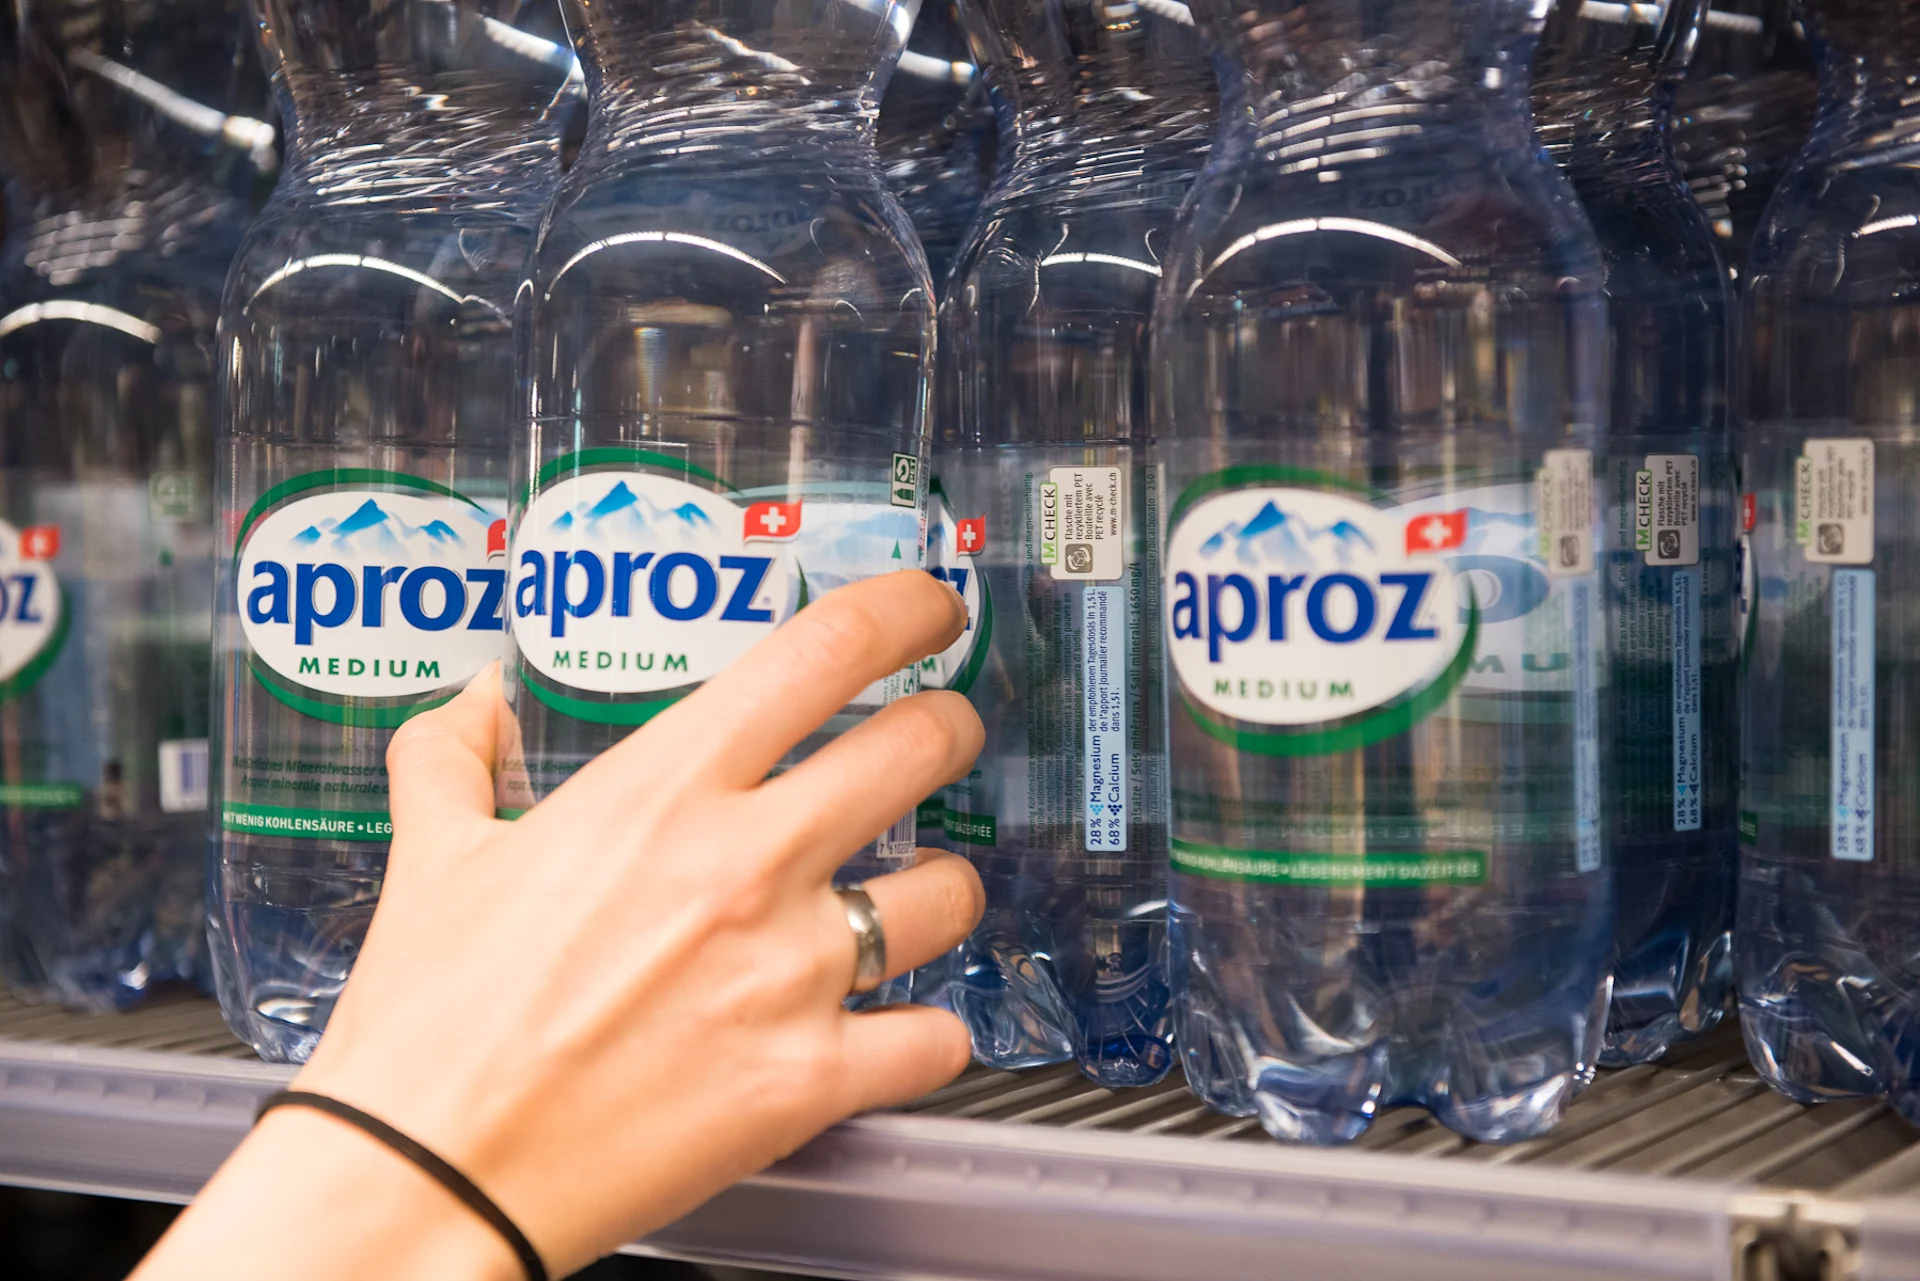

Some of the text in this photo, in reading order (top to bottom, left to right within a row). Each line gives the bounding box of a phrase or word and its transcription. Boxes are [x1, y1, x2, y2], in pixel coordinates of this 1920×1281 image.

[1147, 474, 1156, 490] 250
[1064, 494, 1073, 540] Flasche mit
[1074, 473, 1084, 540] rezykliertem PET
[1084, 503, 1093, 540] Bouteille
[1095, 495, 1105, 540] PET recyclé
[516, 550, 776, 638] aproz
[1087, 611, 1096, 619] in
[1097, 591, 1107, 643] recommandé
[1173, 571, 1440, 663] aproz
[552, 649, 689, 672] MEDIUM
[1086, 621, 1098, 664] Tagesdosis
[1129, 619, 1140, 667] minerali:
[298, 656, 441, 678] MEDIUM
[1097, 645, 1108, 685] journalier
[1129, 671, 1140, 689] Sali
[1087, 665, 1098, 718] empfohlenen
[1215, 678, 1354, 700] MEDIUM
[1087, 719, 1096, 732] der
[1098, 721, 1107, 732] de
[1110, 712, 1120, 732] dans
[1131, 701, 1141, 749] minéraux
[286, 760, 378, 776] Mineralwasser
[1090, 735, 1103, 802] Magnesium
[1131, 753, 1142, 775] Sels
[1676, 717, 1688, 783] Magnesium
[1689, 734, 1698, 782] Calcium
[271, 777, 321, 792] minerale
[324, 781, 380, 793] naturale
[1108, 753, 1120, 803] Calcium
[1855, 753, 1868, 807] Calcium
[235, 813, 264, 827] WENIG
[265, 813, 354, 833] KOHLENSÄURE
